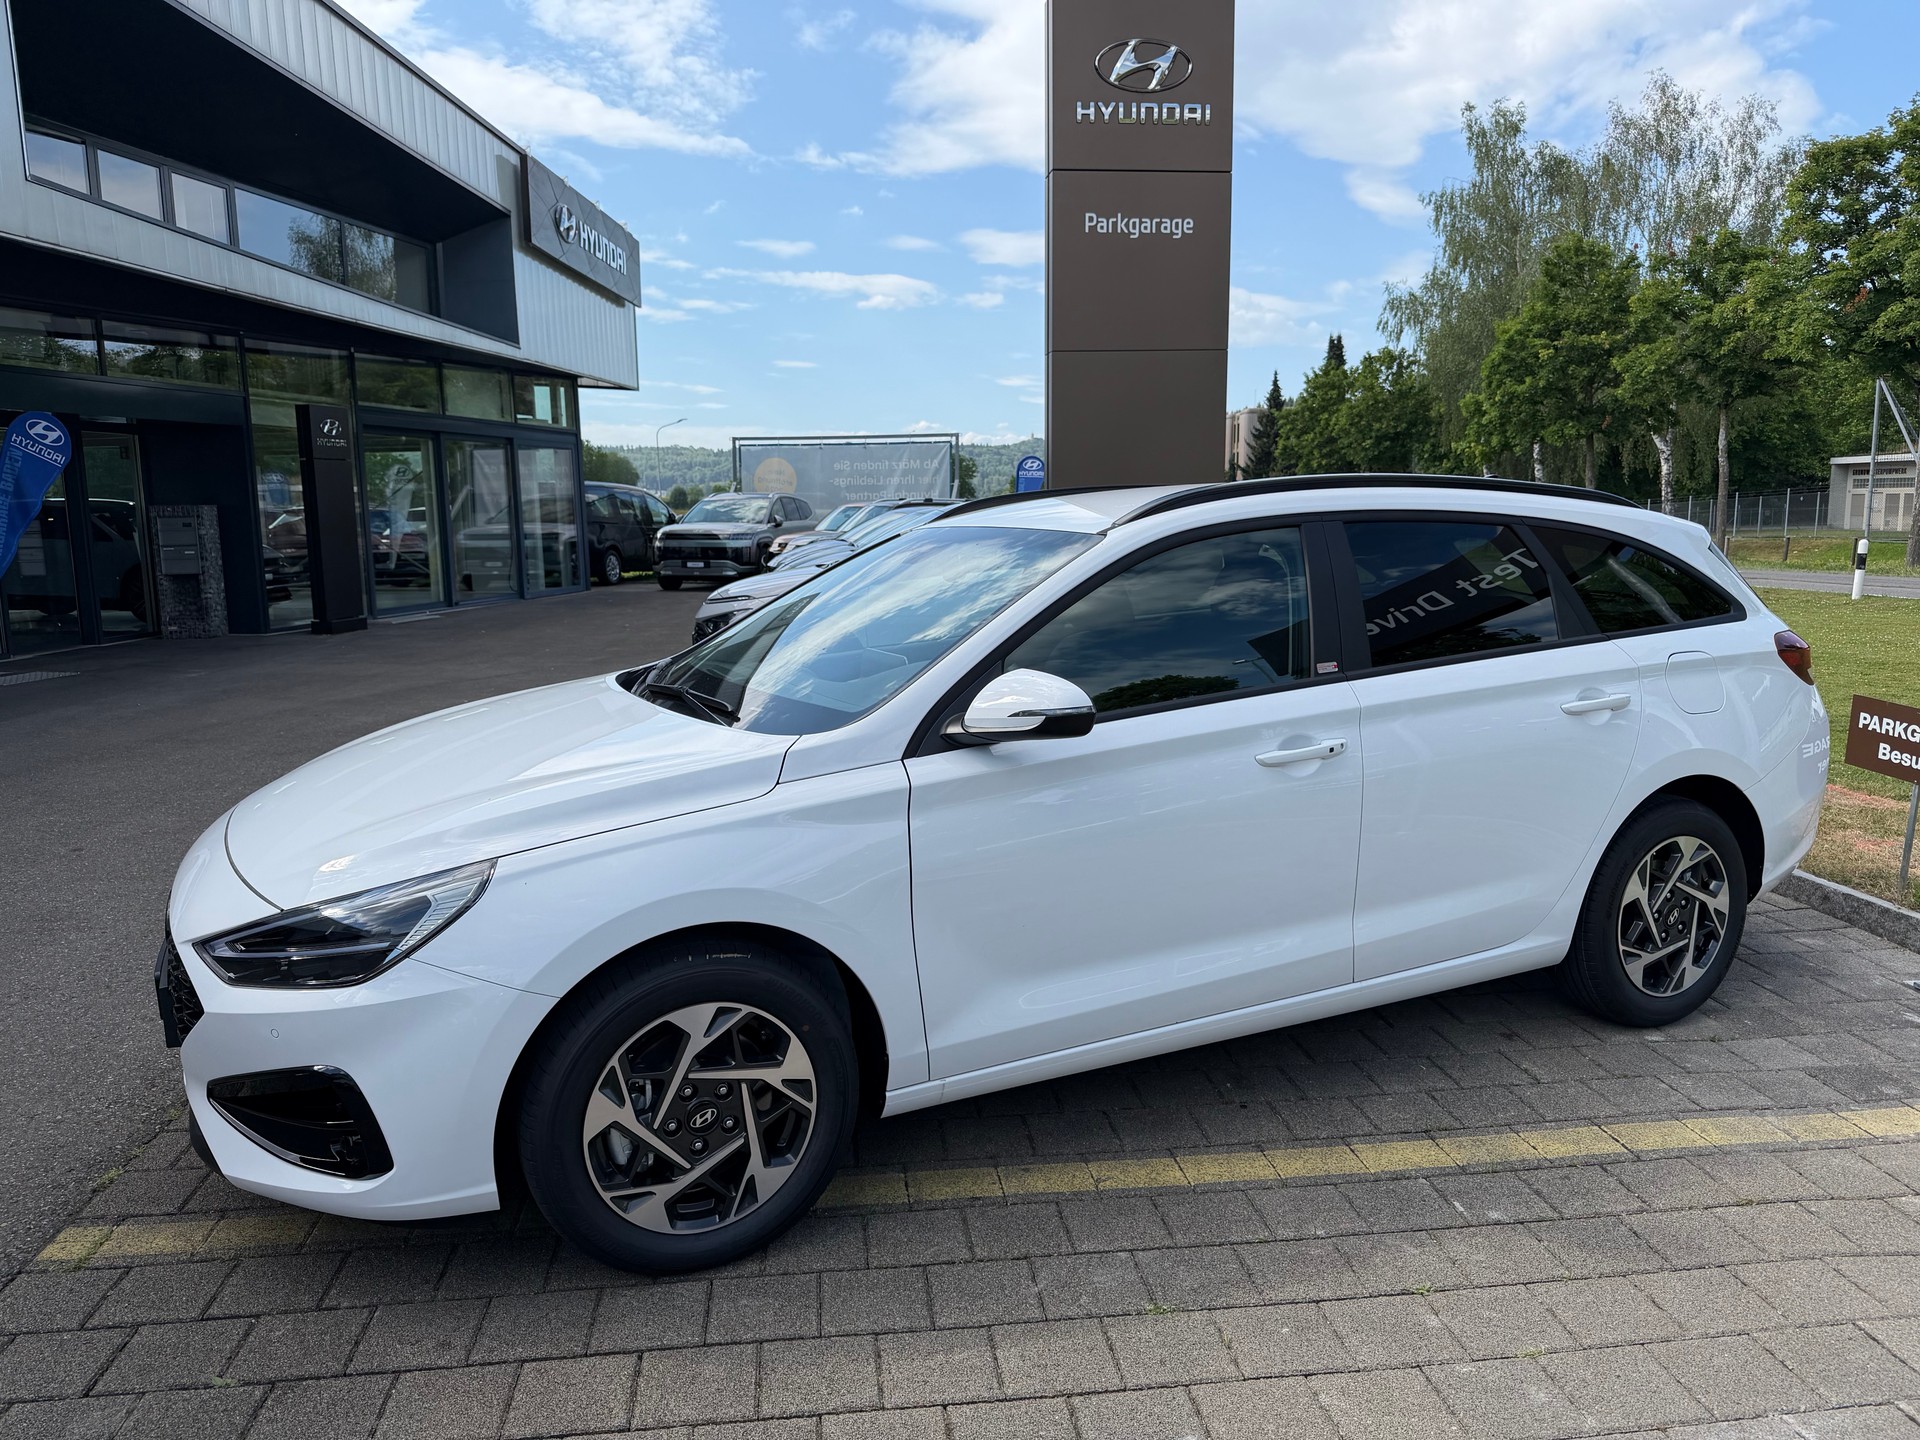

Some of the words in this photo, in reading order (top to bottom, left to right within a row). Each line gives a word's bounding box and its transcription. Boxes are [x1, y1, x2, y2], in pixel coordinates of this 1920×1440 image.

[1076, 101, 1211, 126] HYUNDAI
[1084, 212, 1194, 239] Parkgarage
[579, 220, 627, 275] HYUNDAI
[11, 433, 66, 465] HYUNDAI
[316, 438, 348, 447] HYUNDAI
[1, 447, 23, 492] BADEN
[1858, 711, 1920, 743] PARKG
